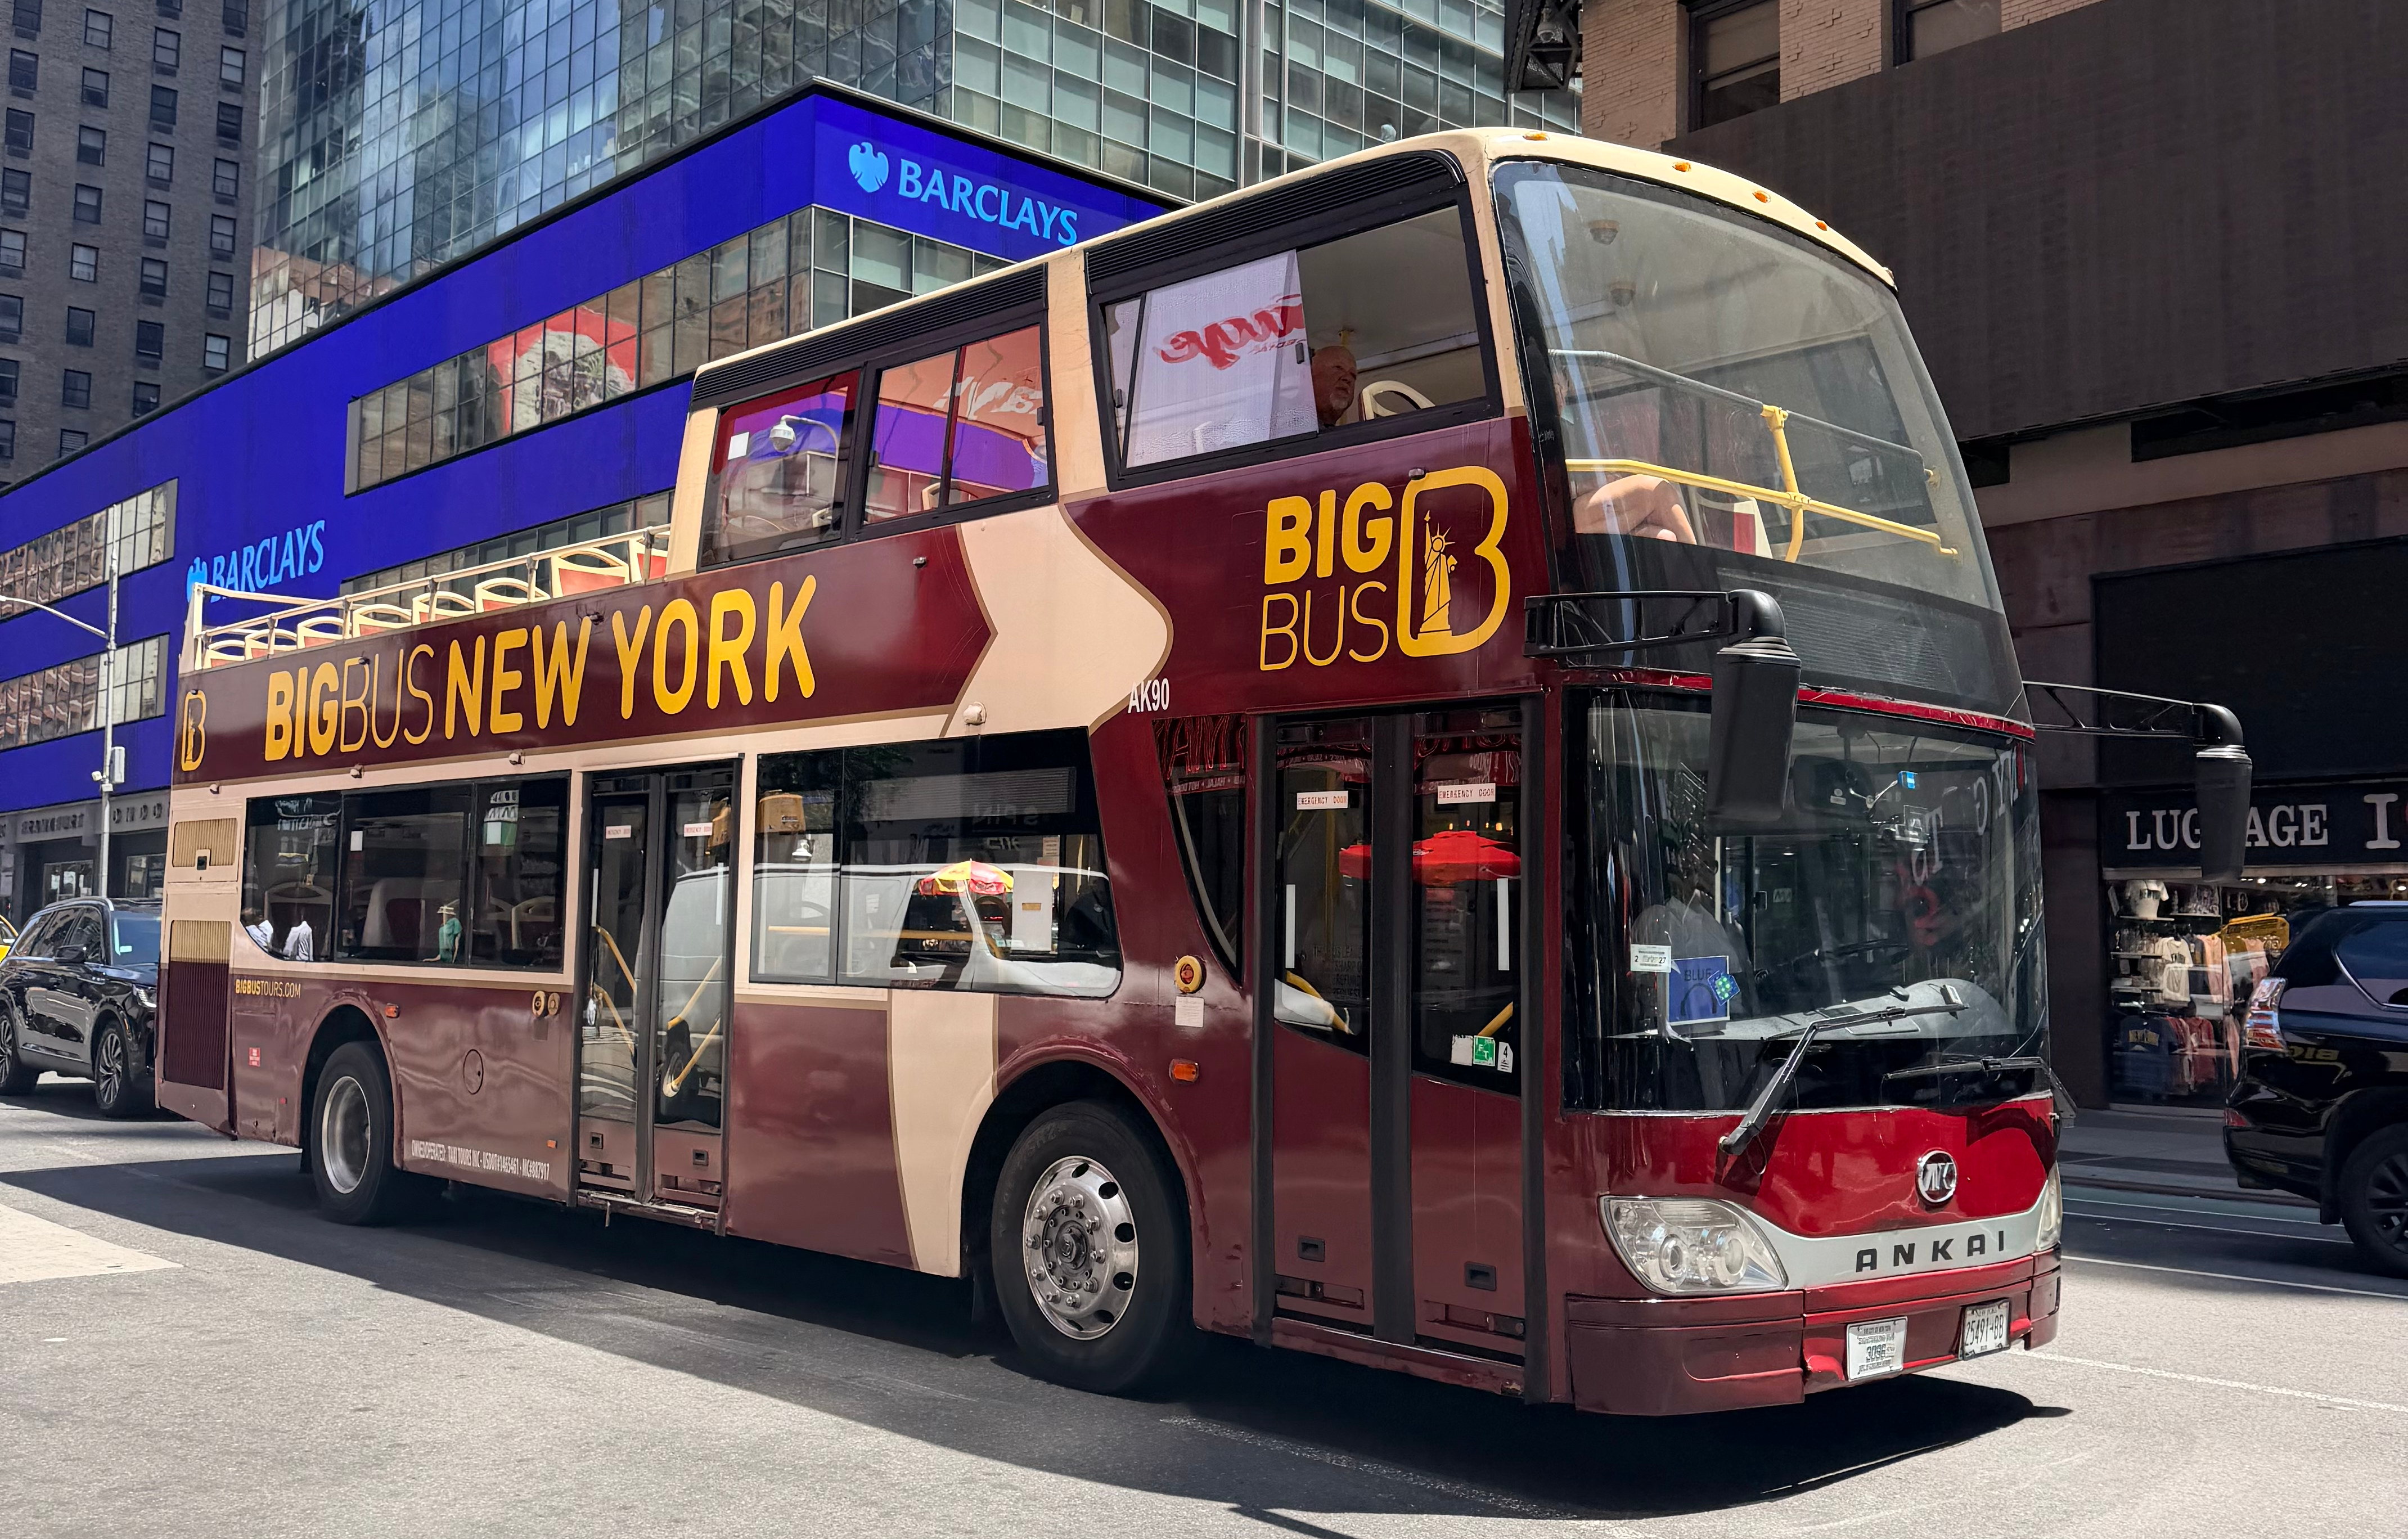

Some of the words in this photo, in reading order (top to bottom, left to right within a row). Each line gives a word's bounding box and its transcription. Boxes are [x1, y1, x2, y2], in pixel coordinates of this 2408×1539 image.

[898, 159, 1078, 246] BARCLAYS
[210, 520, 325, 604] BARCLAYS
[1264, 482, 1393, 585] BIG
[1260, 580, 1389, 671] BUS
[444, 618, 590, 740] NEW
[612, 575, 816, 720] YORK
[1127, 678, 1169, 714] AK90
[1333, 795, 1347, 804] DOOR
[1479, 788, 1495, 796] DOOR
[2126, 804, 2328, 850] LUGAGE
[2364, 793, 2401, 849] I
[235, 979, 301, 998] BIGBUSTOURS.COM
[1856, 1230, 2005, 1272] ANKAI
